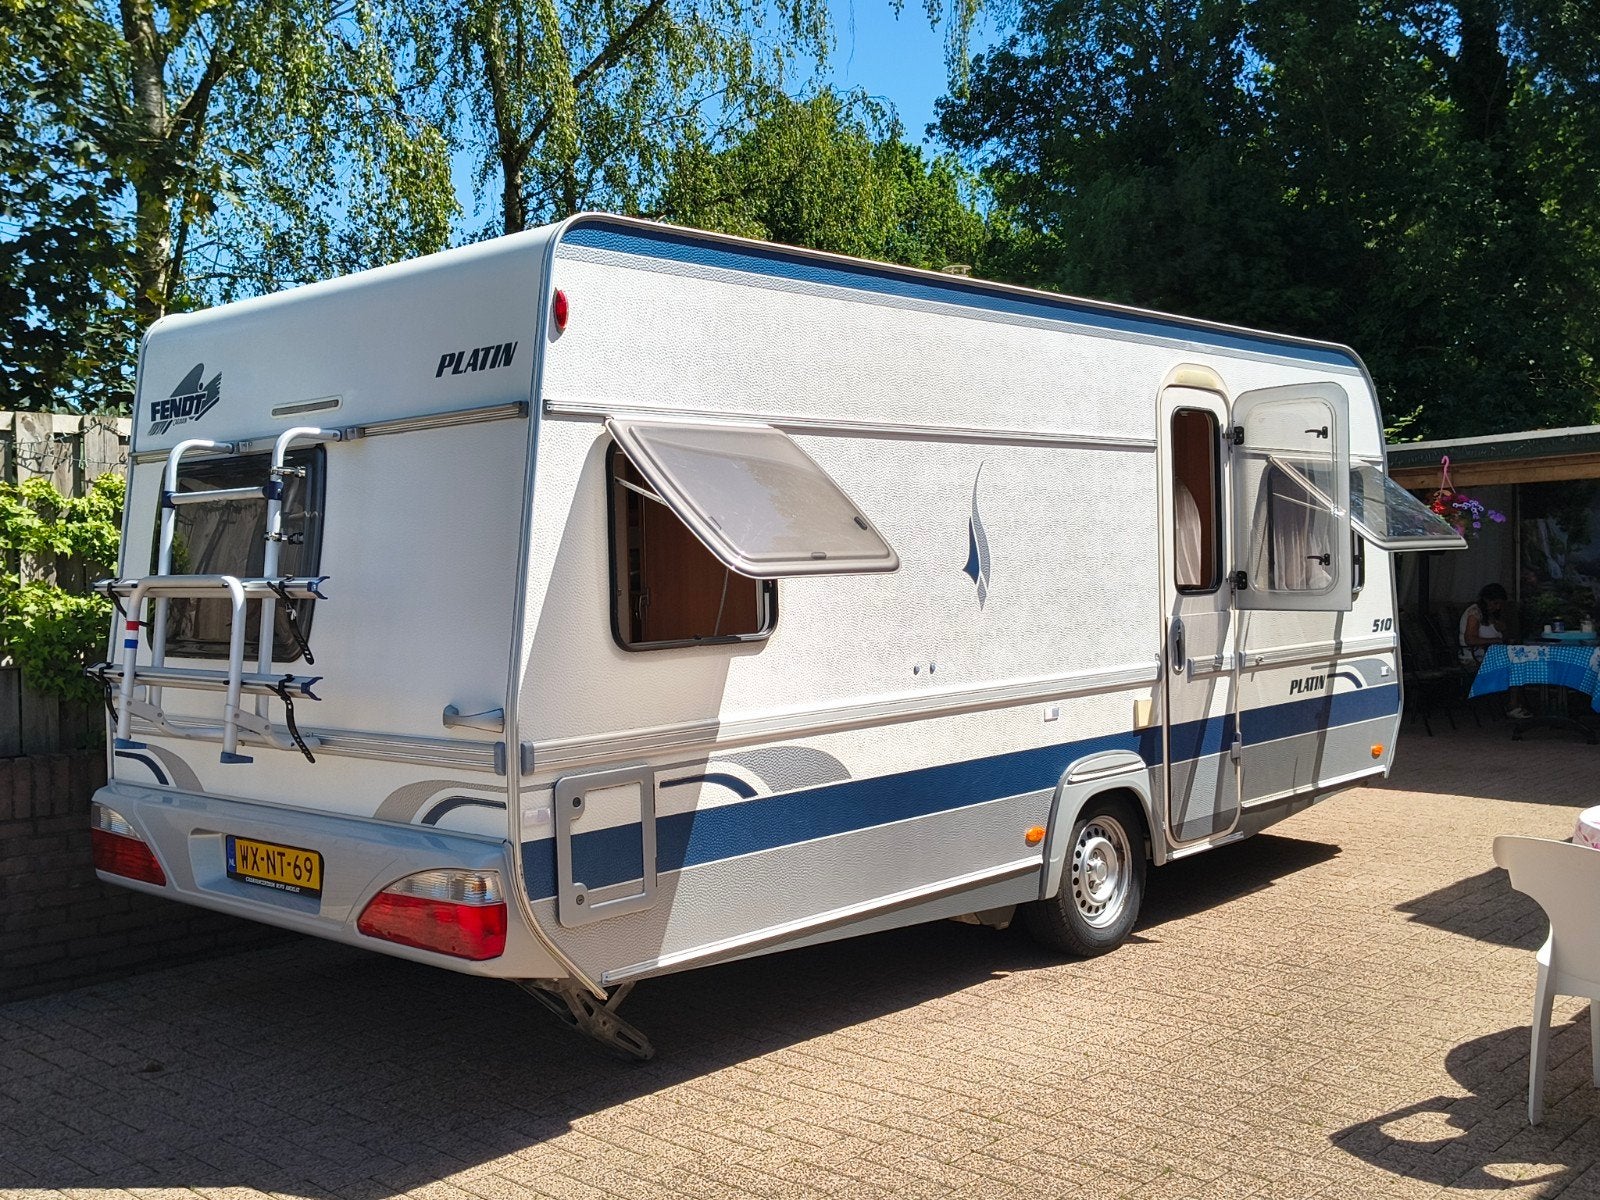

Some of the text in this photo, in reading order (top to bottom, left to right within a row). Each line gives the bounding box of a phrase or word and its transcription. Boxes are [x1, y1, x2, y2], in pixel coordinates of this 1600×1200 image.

[435, 340, 519, 378] PLATIN
[150, 392, 207, 422] FENDT
[1371, 617, 1393, 633] 510
[1289, 675, 1326, 695] PLATIN
[239, 844, 314, 883] WX-NT-69
